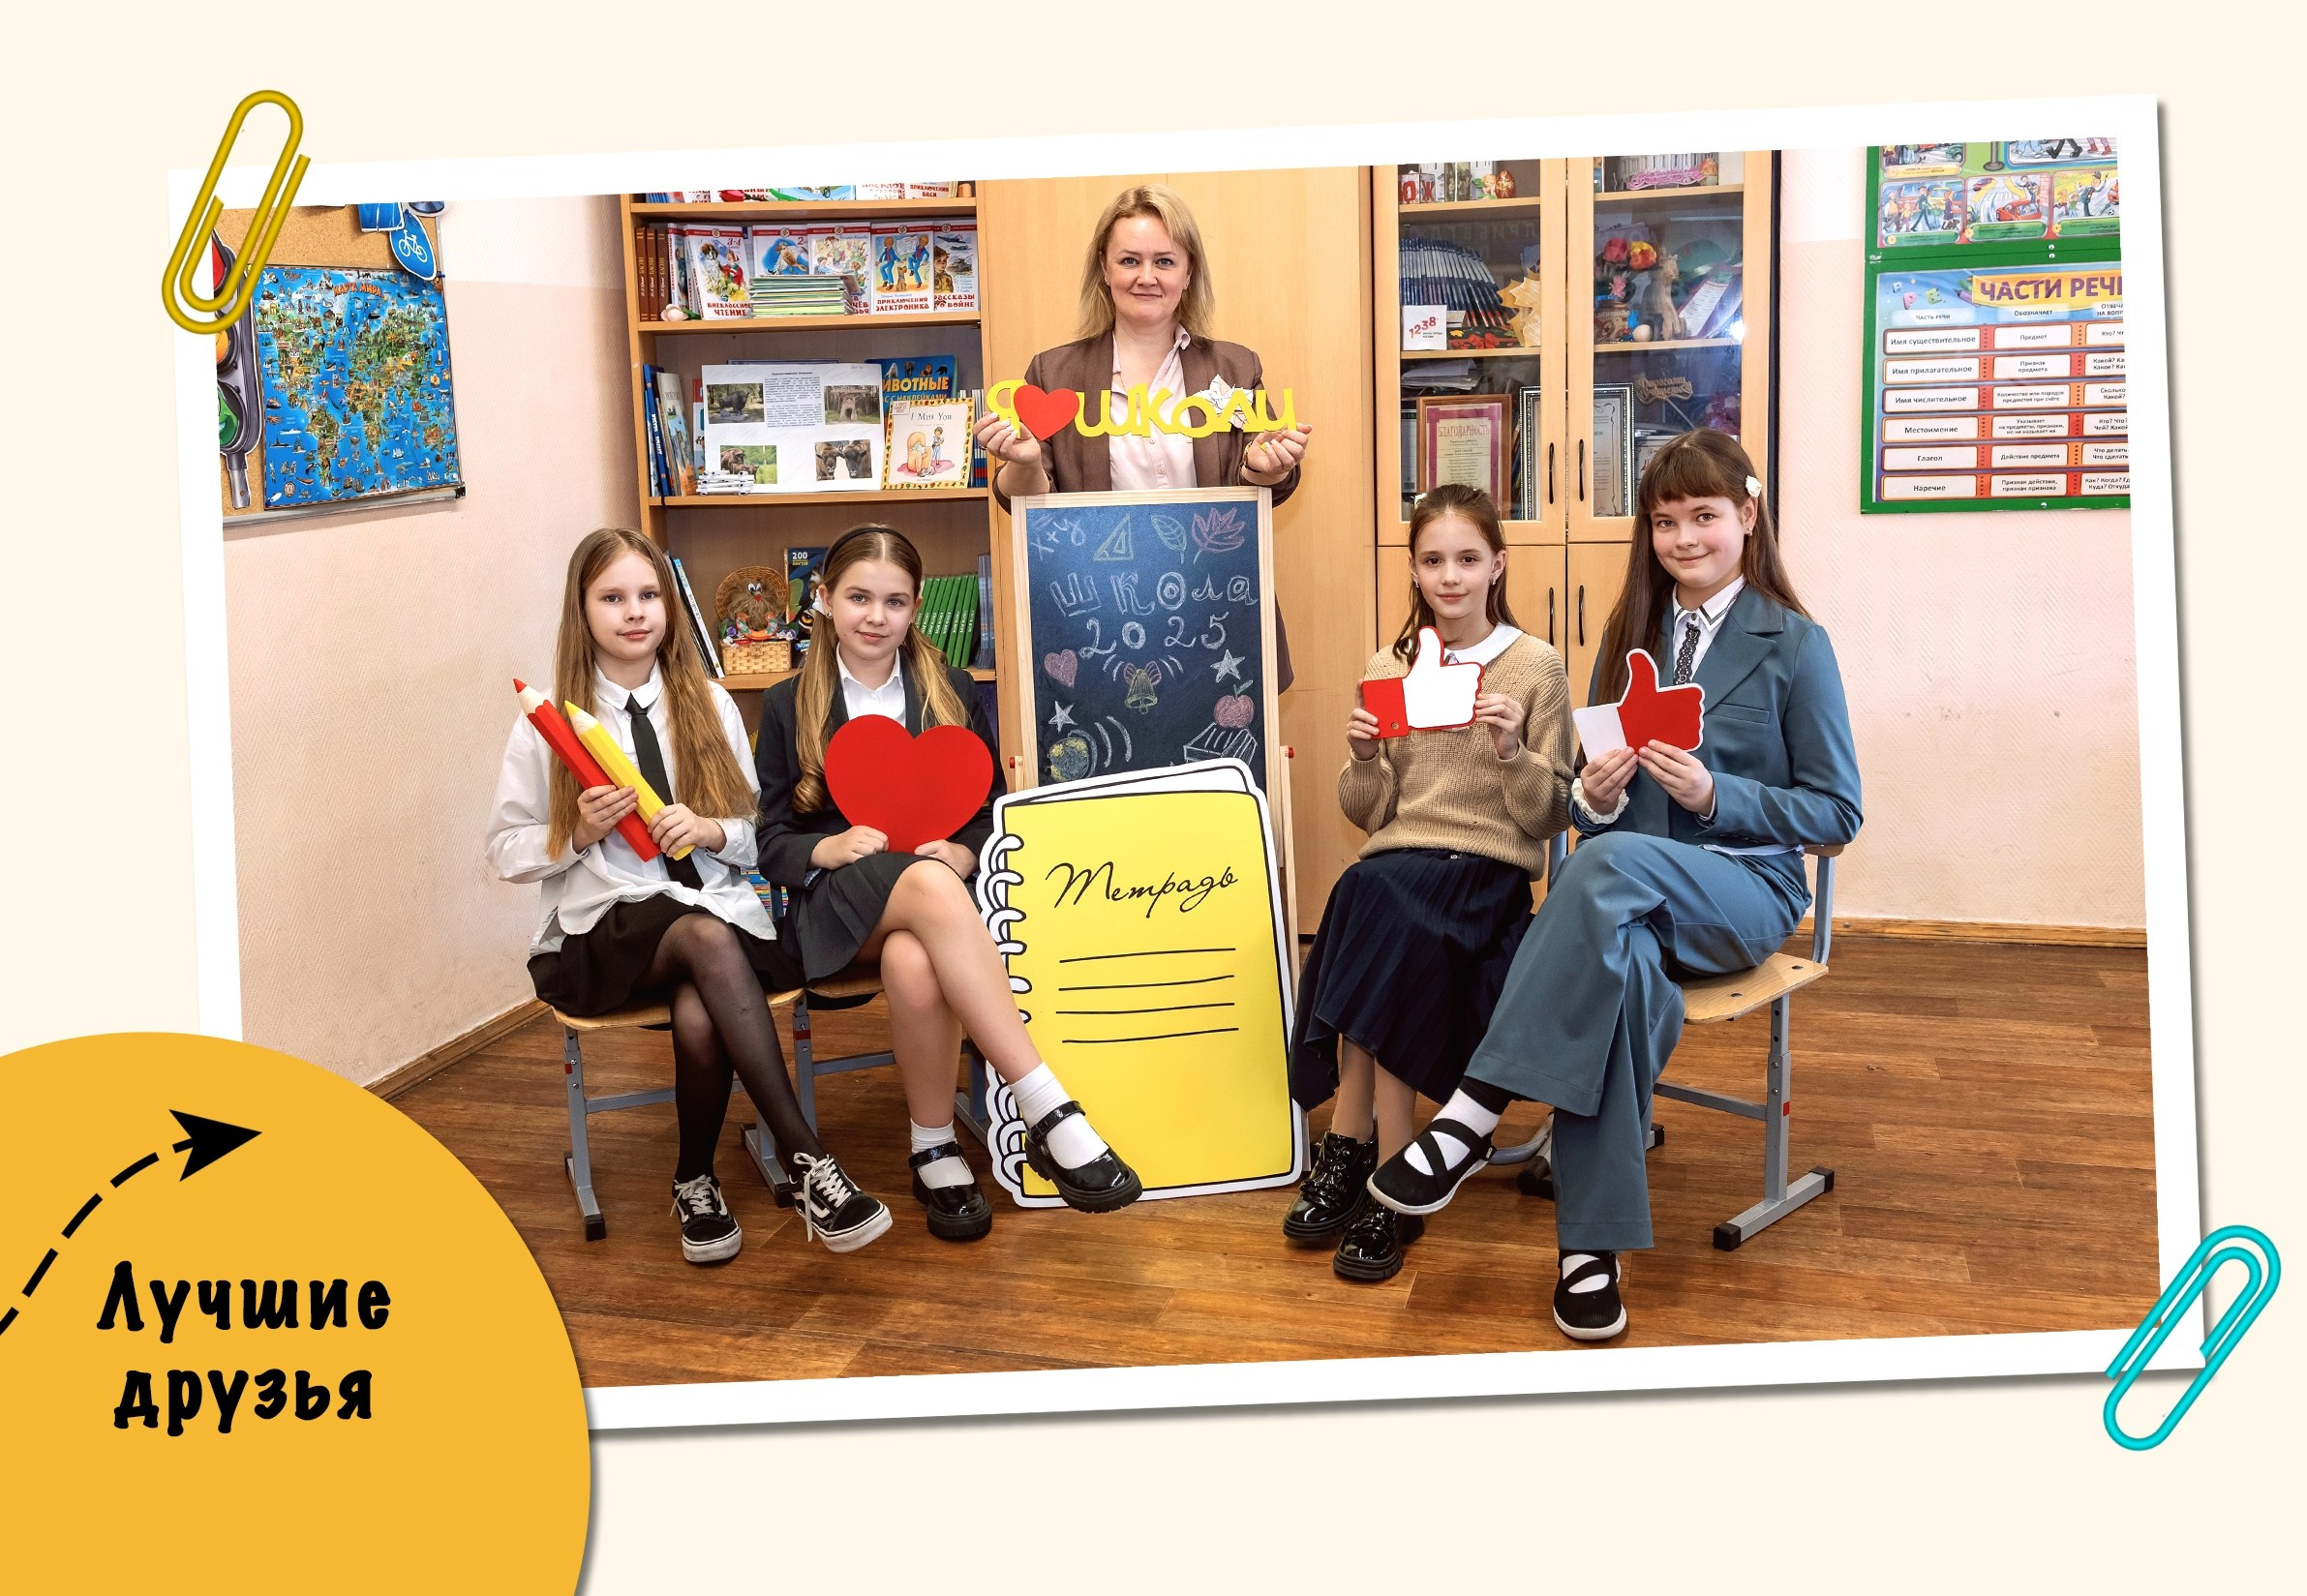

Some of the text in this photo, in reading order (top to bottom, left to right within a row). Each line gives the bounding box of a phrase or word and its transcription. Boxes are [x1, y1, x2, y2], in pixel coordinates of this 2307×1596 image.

[1980, 278, 2062, 301] ЧАСТИ
[1909, 337, 1976, 346] существительное
[1910, 366, 1972, 376] прилагательное
[882, 376, 950, 393] ИВОТНЫЕ
[1439, 425, 1490, 438] БЛАГОДАРНОСТЬ
[1078, 612, 1230, 660] 2025
[1045, 861, 1239, 918] Тетрадь
